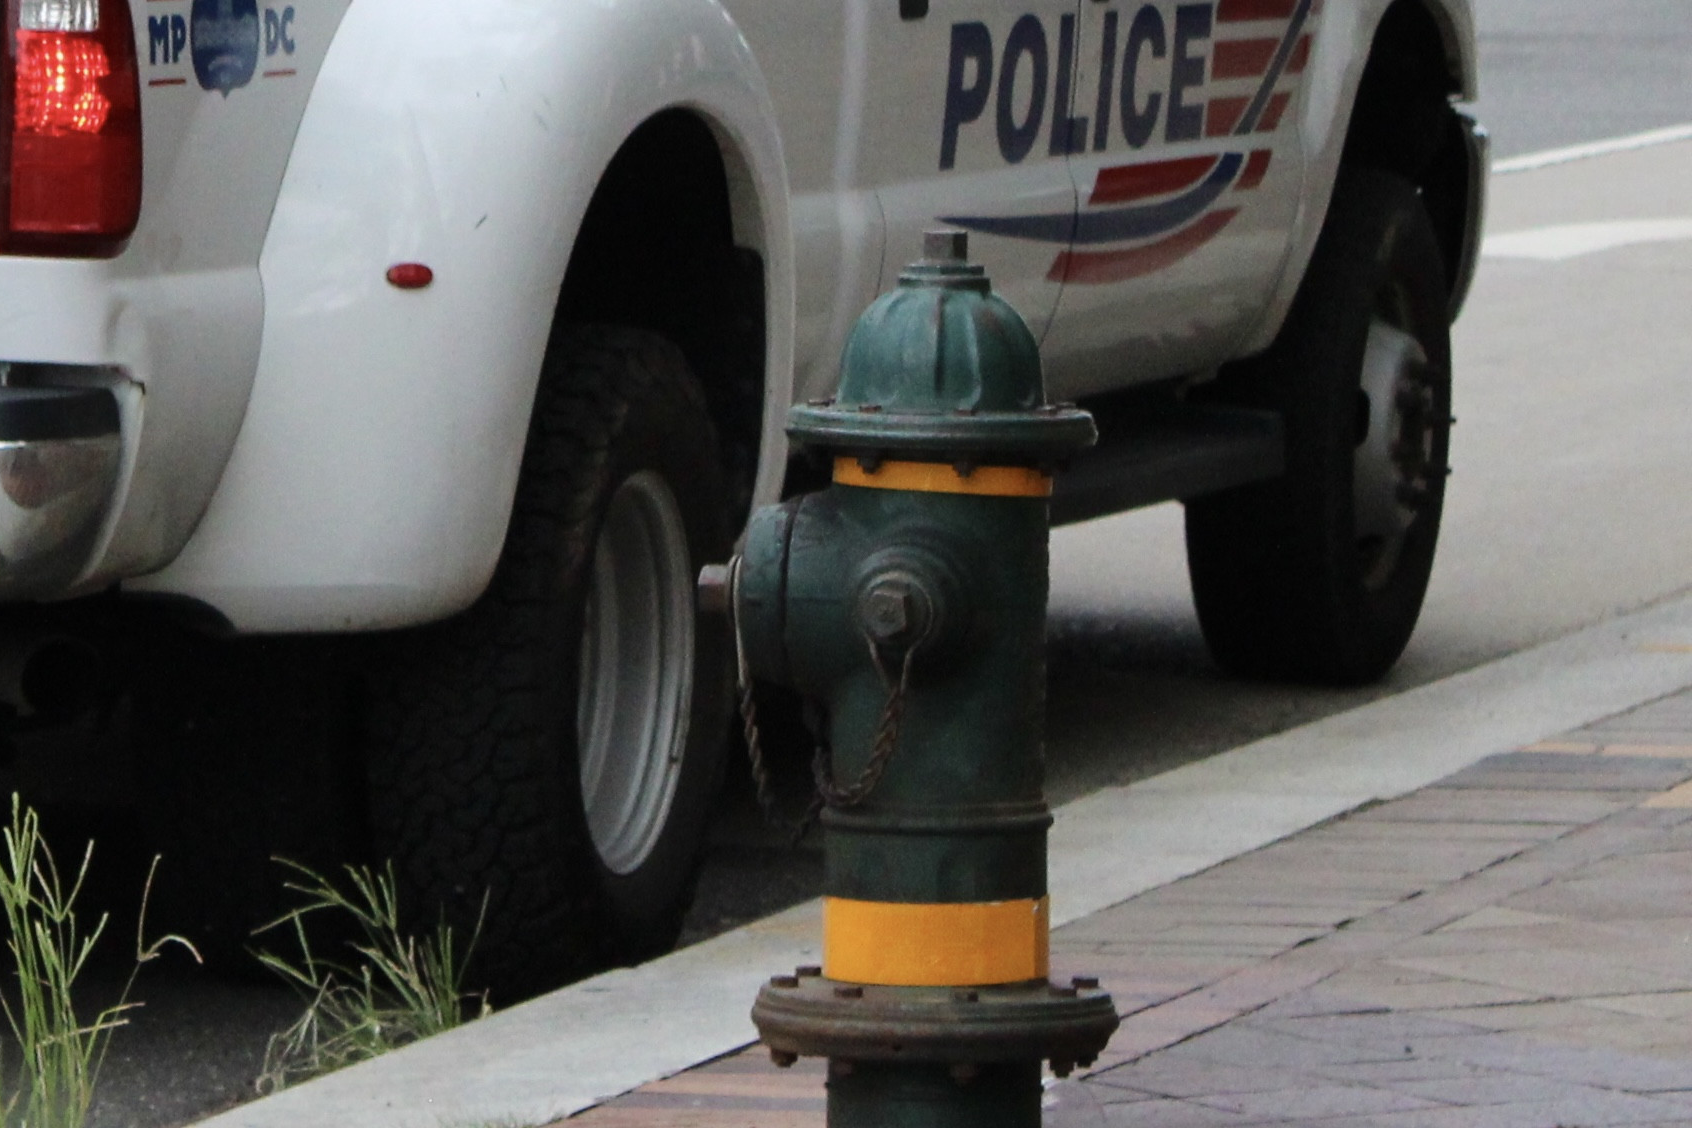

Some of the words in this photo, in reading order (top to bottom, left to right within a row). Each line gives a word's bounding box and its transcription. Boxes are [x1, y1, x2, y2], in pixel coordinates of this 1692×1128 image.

[148, 14, 187, 65] MP
[265, 4, 295, 56] DC
[939, 3, 1213, 170] POLICE
